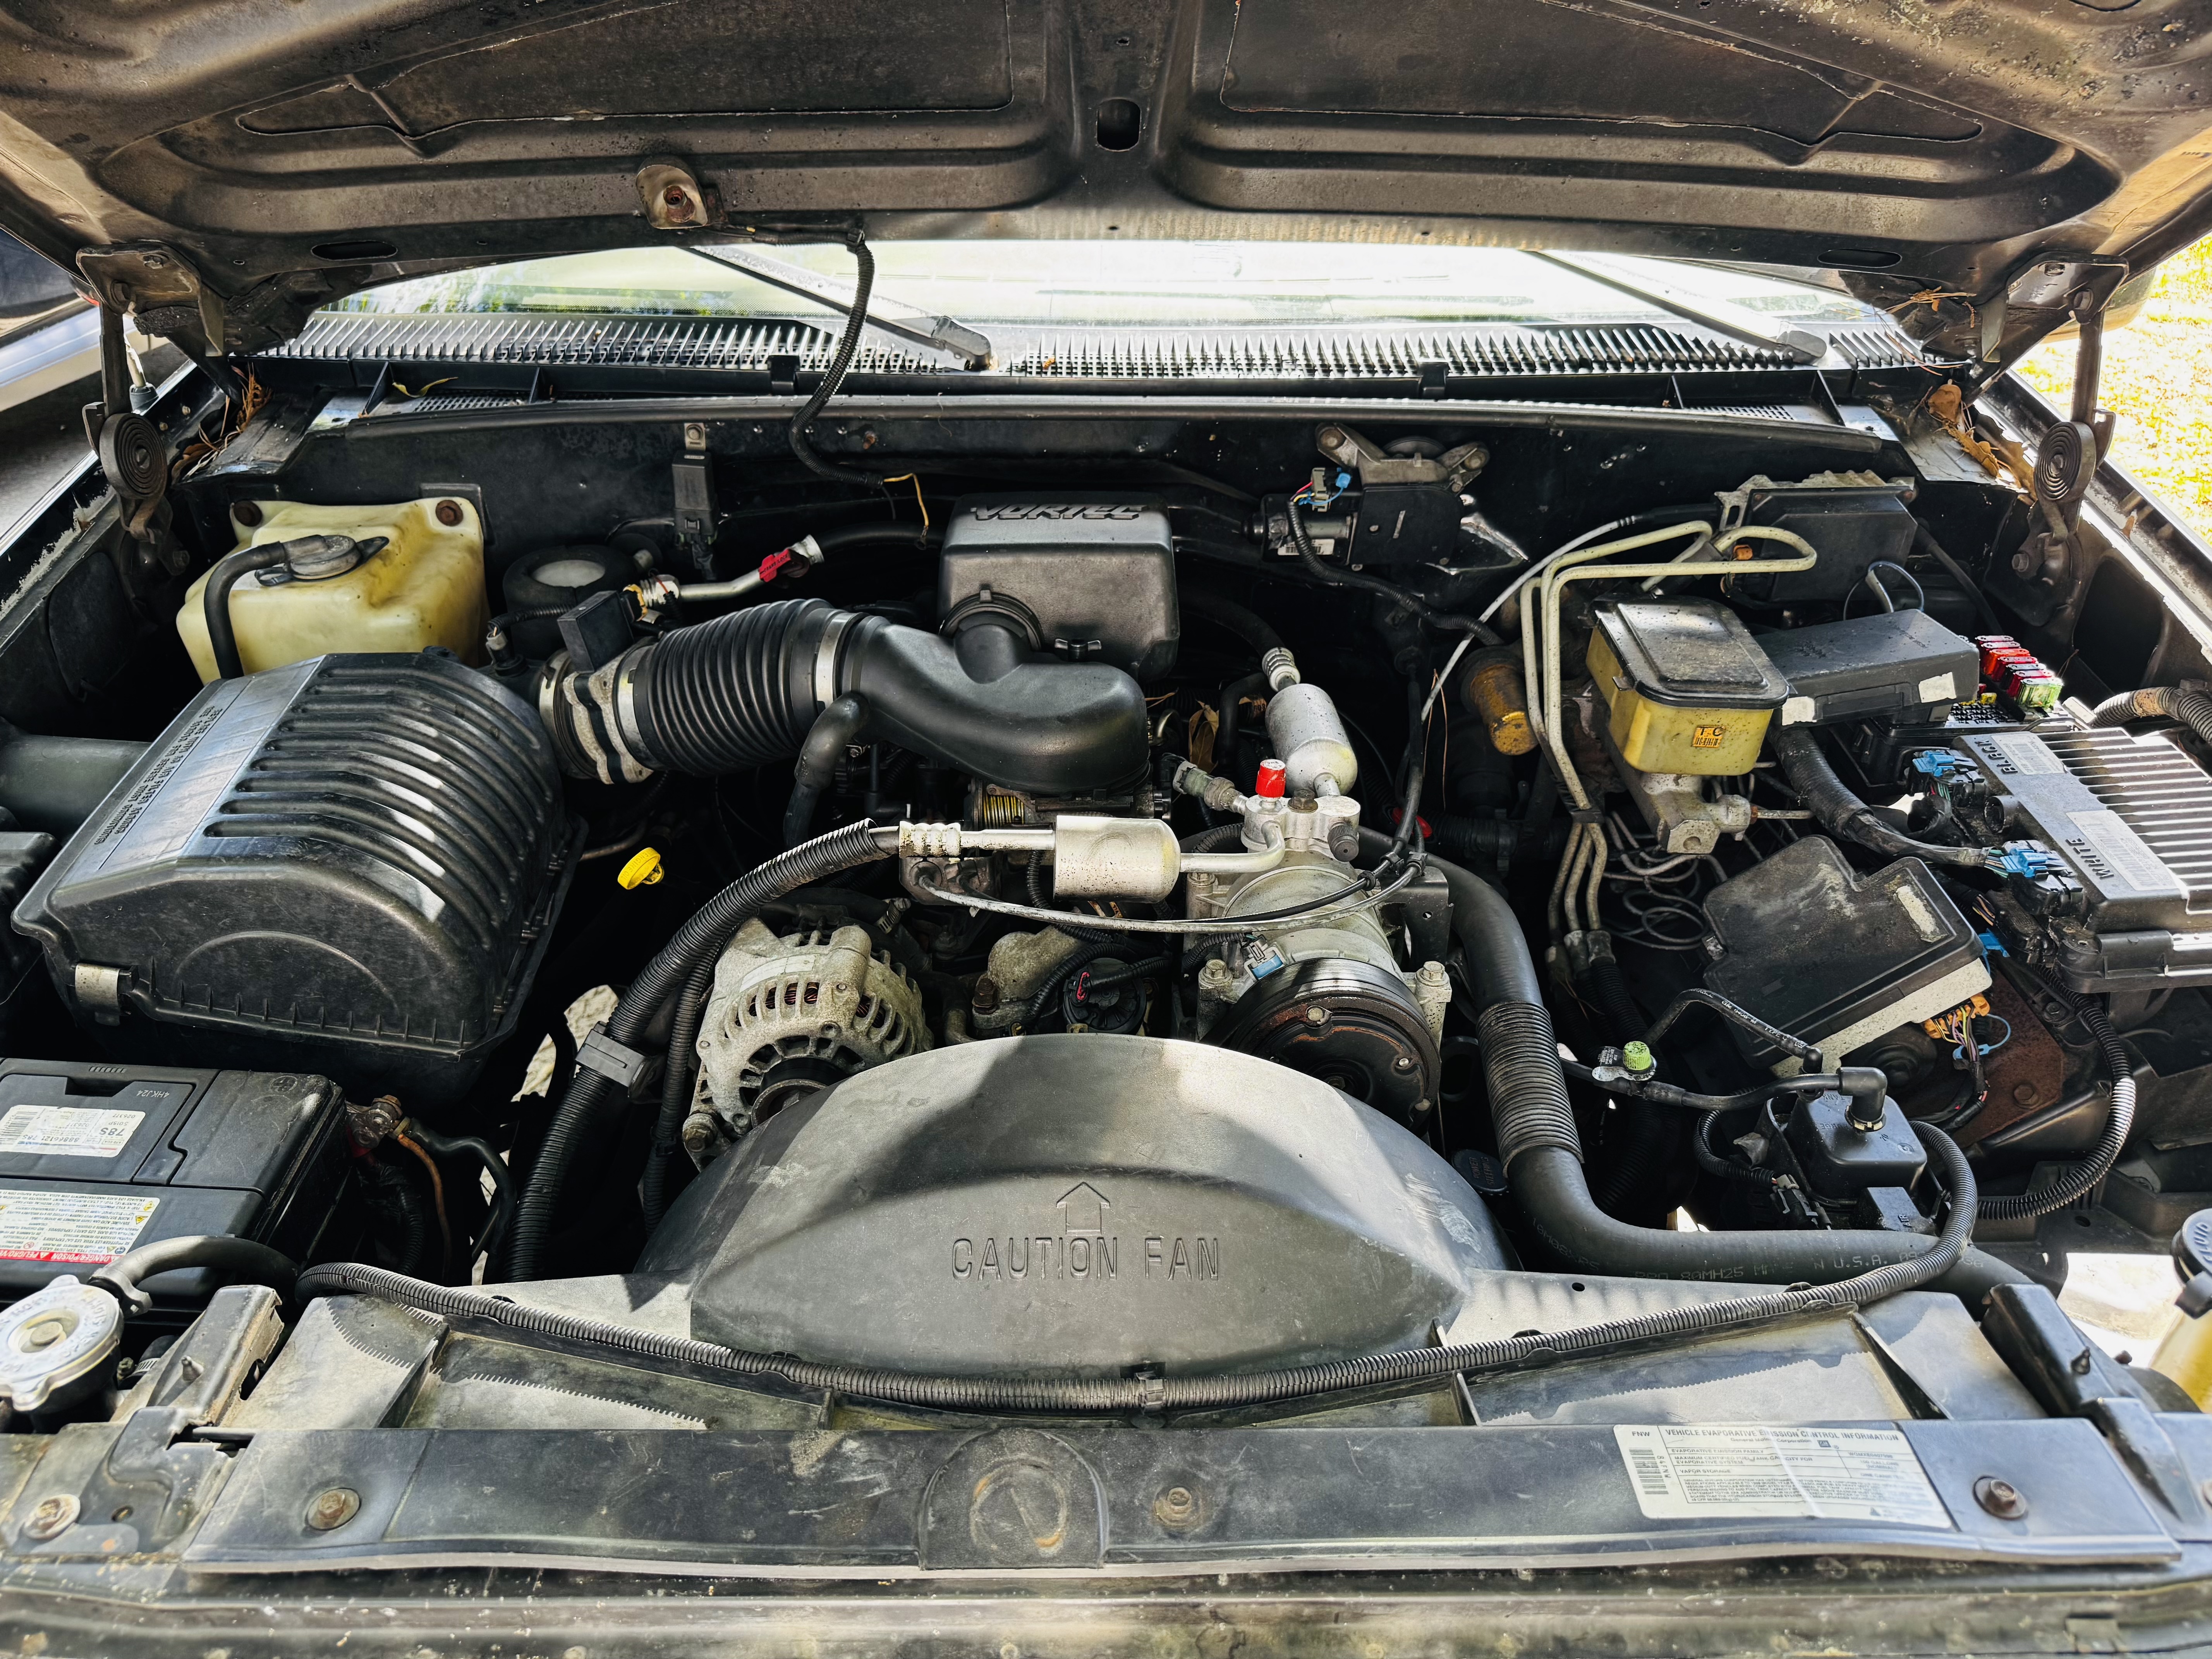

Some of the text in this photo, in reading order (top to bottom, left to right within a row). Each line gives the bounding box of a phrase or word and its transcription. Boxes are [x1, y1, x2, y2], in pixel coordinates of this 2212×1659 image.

[970, 504, 1147, 520] VORTEC
[1975, 740, 2018, 774] BLACK
[2066, 838, 2114, 879] WHITE
[136, 1089, 170, 1098] 4HKJ24
[1822, 1092, 1845, 1101] TANK
[97, 1127, 127, 1136] 78S
[1898, 1214, 1912, 1228] AIR
[49, 1253, 112, 1262] DANGER/POISON
[952, 1237, 1219, 1281] CAUTION FAN
[1834, 1254, 1888, 1269] U.S.A.
[1841, 1432, 1899, 1441] INFORMATION
